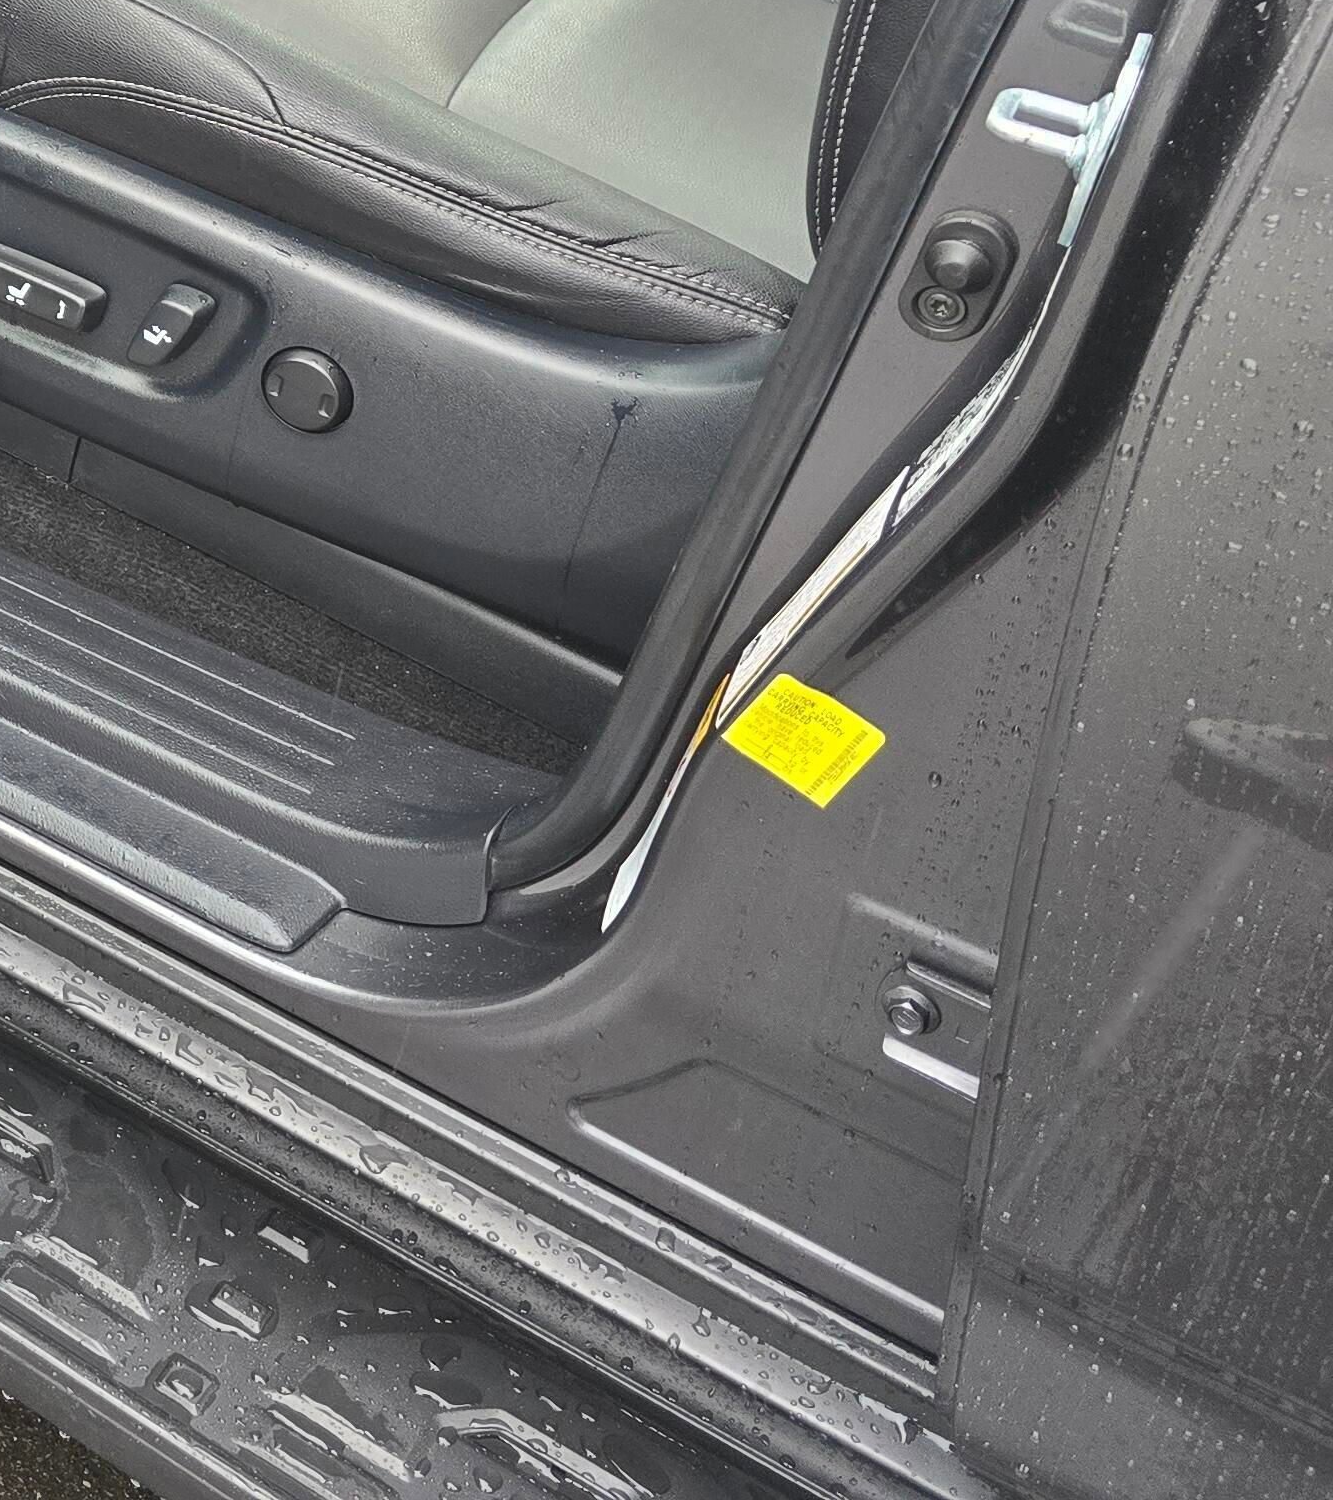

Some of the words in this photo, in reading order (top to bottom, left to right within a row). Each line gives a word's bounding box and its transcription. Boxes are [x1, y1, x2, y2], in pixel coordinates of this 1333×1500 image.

[767, 688, 806, 716] CARRYING
[808, 710, 844, 738] CAPACITY
[775, 702, 812, 725] REDUCED
[820, 708, 843, 725] LOAD
